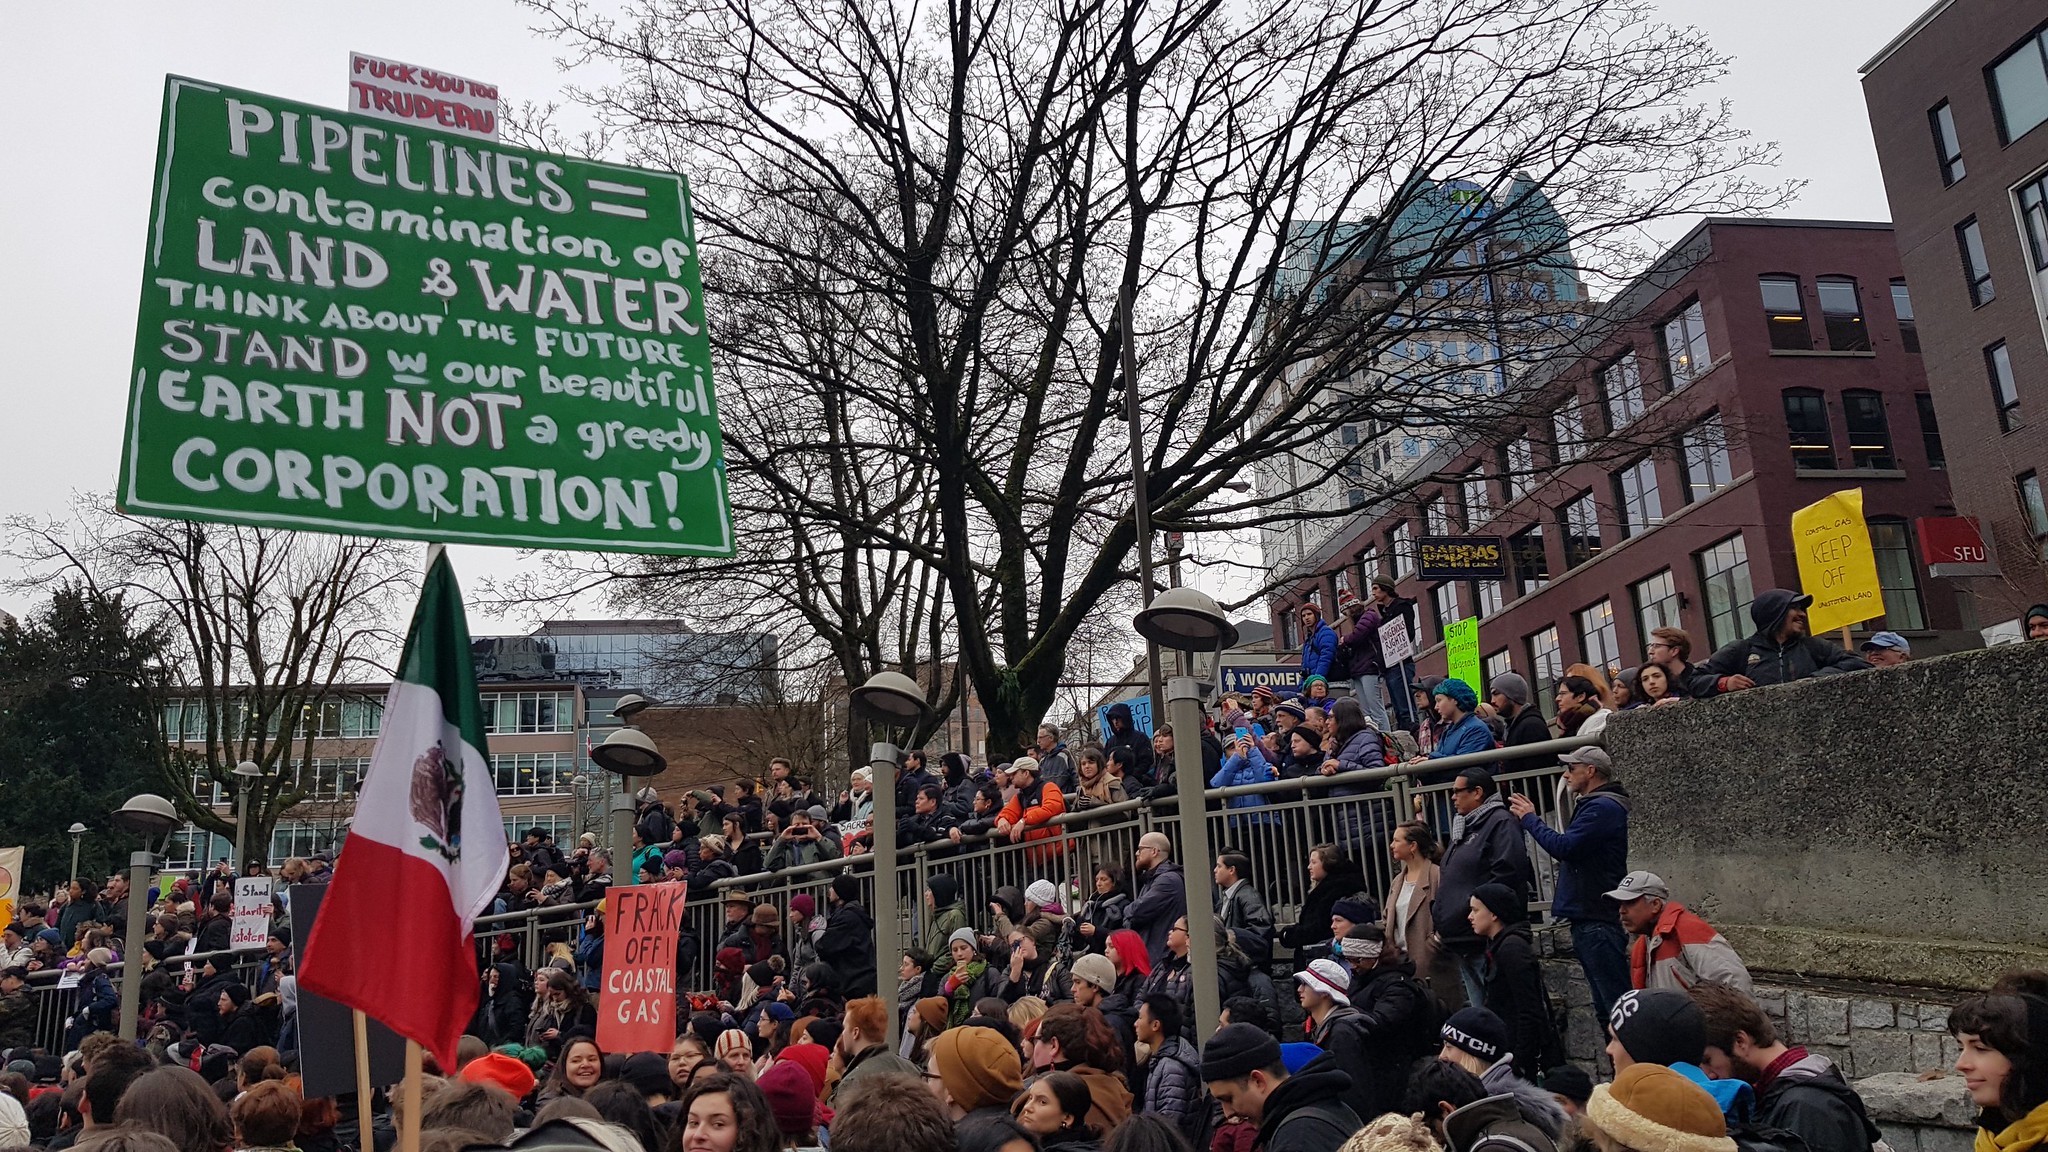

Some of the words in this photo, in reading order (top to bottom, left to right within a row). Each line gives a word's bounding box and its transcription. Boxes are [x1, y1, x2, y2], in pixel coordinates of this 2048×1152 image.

[353, 56, 418, 85] FUCK
[420, 67, 465, 94] YOU
[465, 80, 499, 100] TOO
[350, 81, 495, 134] TRUDEAU
[225, 98, 575, 213] PIPELINES
[202, 176, 621, 268] contamination
[633, 238, 691, 279] of
[197, 216, 390, 289] LAND
[421, 257, 459, 298] &
[466, 259, 700, 336] WATER
[155, 278, 311, 325] THINK
[319, 303, 443, 337] ABOUT
[457, 318, 517, 346] THE
[160, 319, 370, 379] STAND
[442, 361, 526, 388] our
[538, 365, 711, 416] beautiful
[158, 369, 364, 429] EARTH
[384, 388, 523, 450] NOT
[525, 415, 558, 443] a
[577, 418, 712, 471] greedy
[171, 437, 684, 531] CORPORATION!
[1834, 518, 1852, 528] GAS
[1811, 535, 1852, 564] KEEP
[1953, 546, 1985, 561] SFU
[1822, 566, 1846, 589] OFF
[1852, 590, 1873, 601] LAND
[1385, 631, 1406, 652] RIGHTS
[1449, 621, 1468, 638] STOP
[242, 884, 270, 897] Stand
[614, 888, 685, 934] FRACK
[625, 936, 670, 965] OFF!
[608, 968, 673, 994] COASTAL
[617, 999, 661, 1024] GAS
[1440, 1023, 1497, 1056] WATCH
